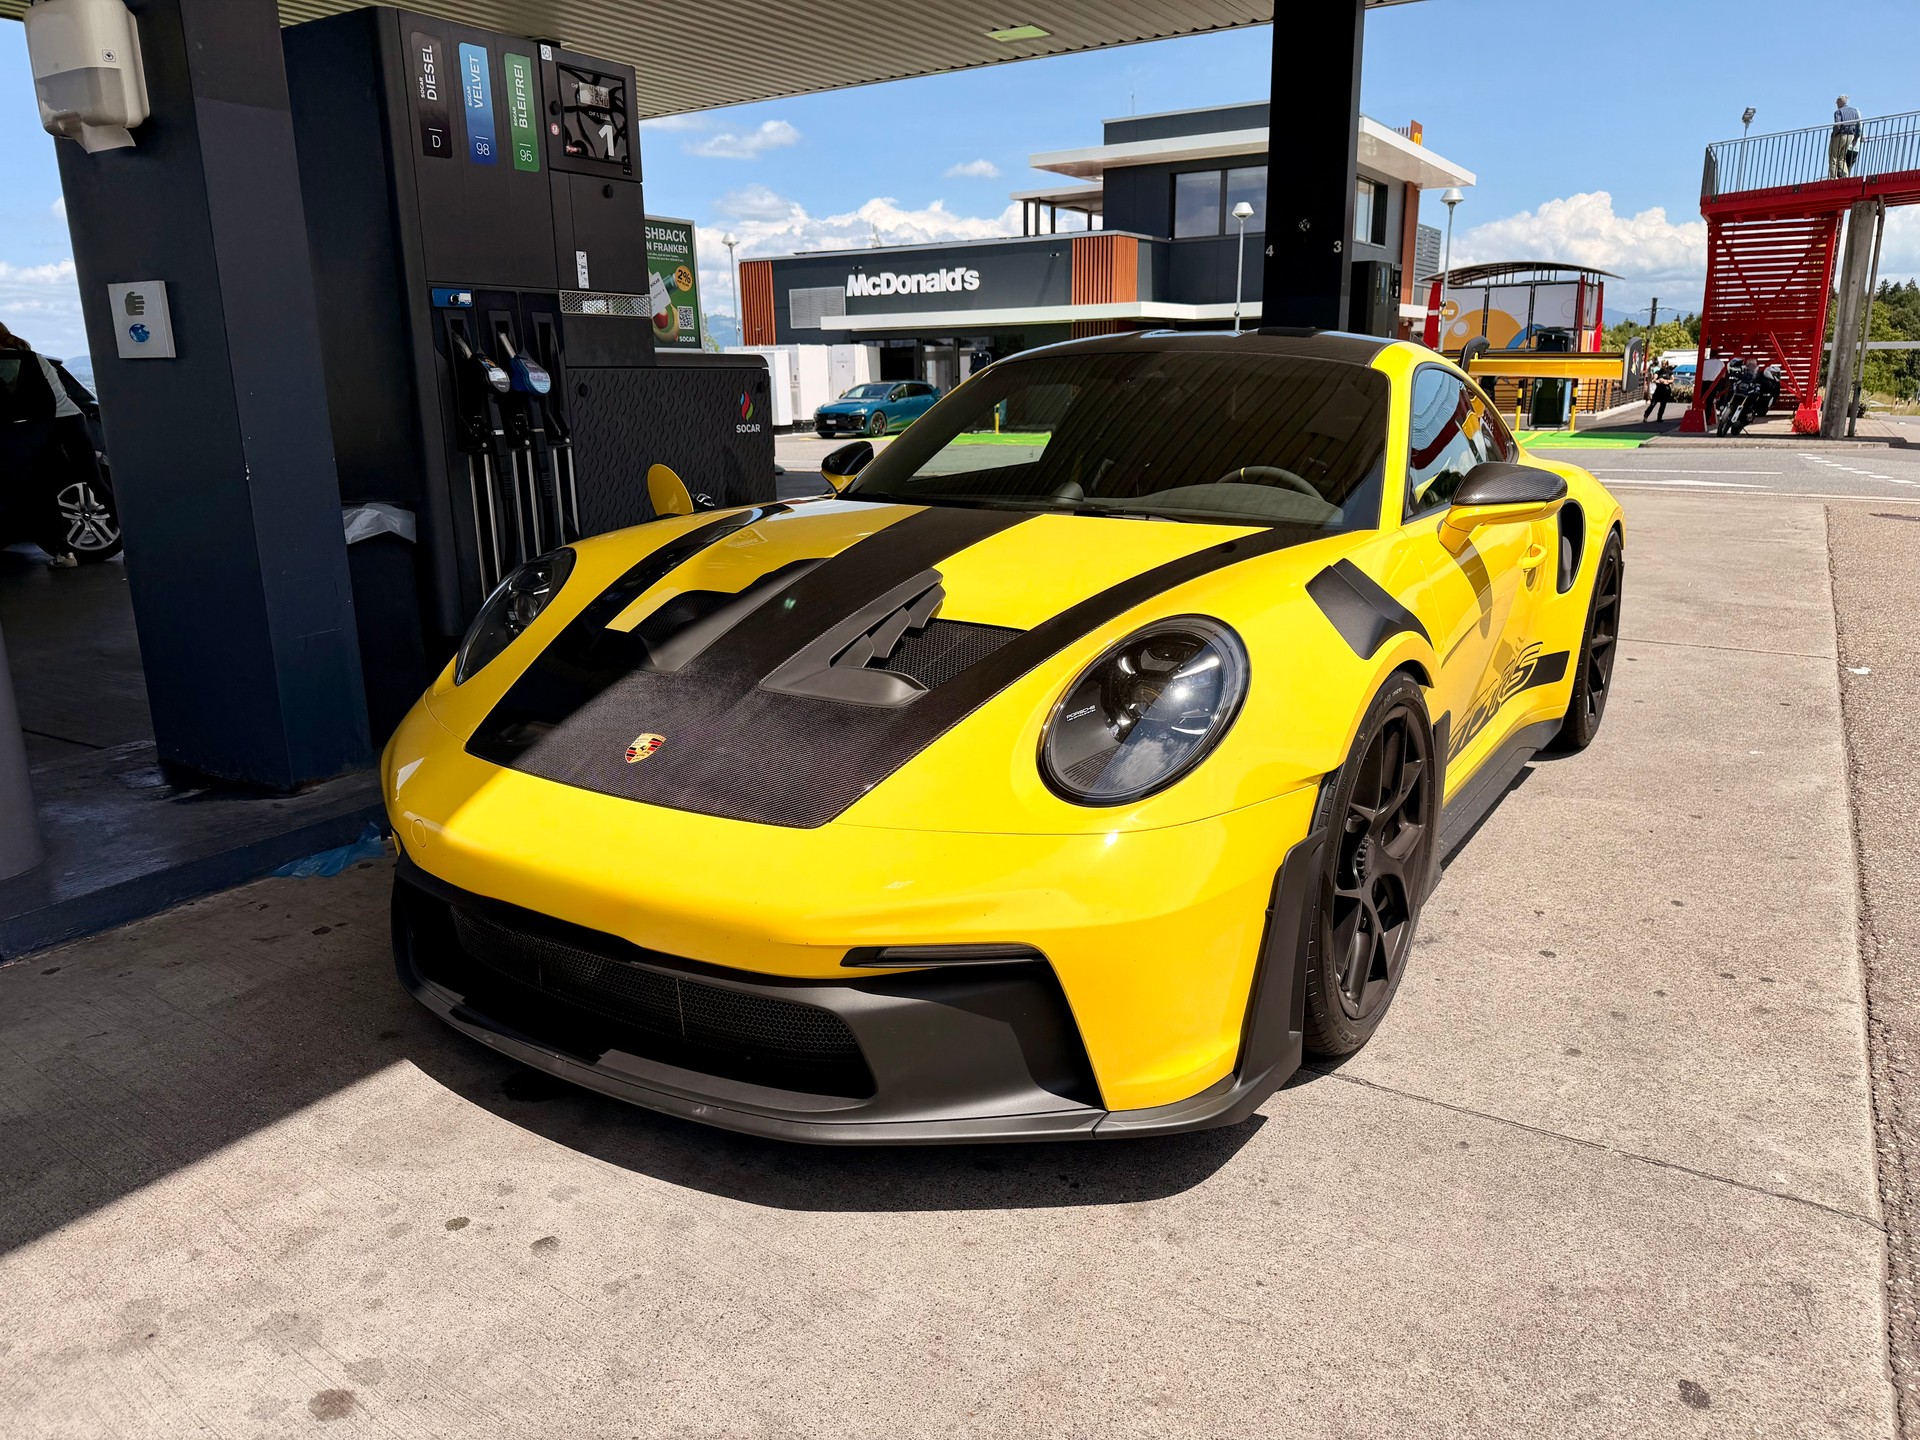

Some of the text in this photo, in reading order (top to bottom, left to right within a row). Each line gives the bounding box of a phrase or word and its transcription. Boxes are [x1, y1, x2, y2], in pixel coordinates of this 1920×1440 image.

[422, 45, 438, 101] DIESEL
[469, 54, 484, 108] VELVET
[514, 64, 528, 128] BLEIFREI
[432, 135, 441, 148] D
[598, 124, 615, 157] 1
[476, 142, 490, 156] 98
[519, 149, 533, 163] 95
[653, 242, 688, 254] FRANKEN
[1265, 244, 1274, 257] 4
[1333, 240, 1342, 253] 3
[677, 269, 691, 284] 2%
[846, 267, 980, 297] McDonald's
[736, 424, 761, 433] SOCAR
